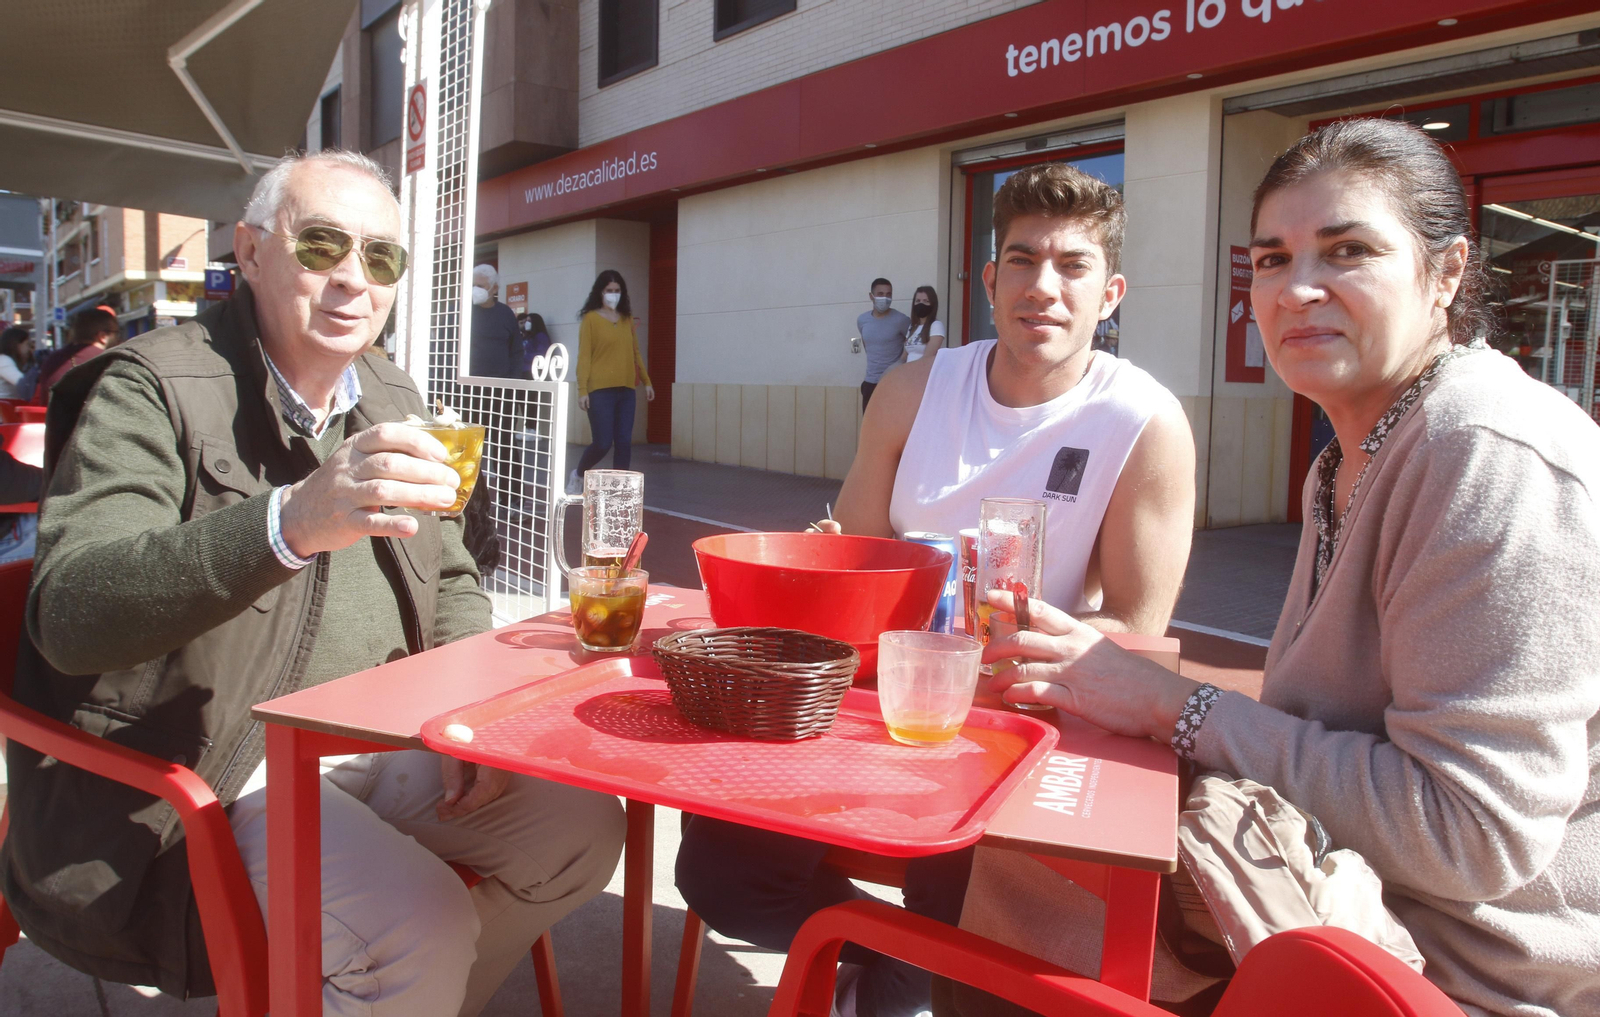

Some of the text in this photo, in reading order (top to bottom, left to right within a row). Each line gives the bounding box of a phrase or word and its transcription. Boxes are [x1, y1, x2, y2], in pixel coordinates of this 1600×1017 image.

[1006, 9, 1171, 77] tenemos
[1186, 0, 1226, 33] lo
[525, 151, 658, 203] www.dezacalidad.es
[211, 272, 225, 288] P
[1042, 491, 1077, 503] DARK SUN
[1033, 755, 1089, 816] AMBAR
